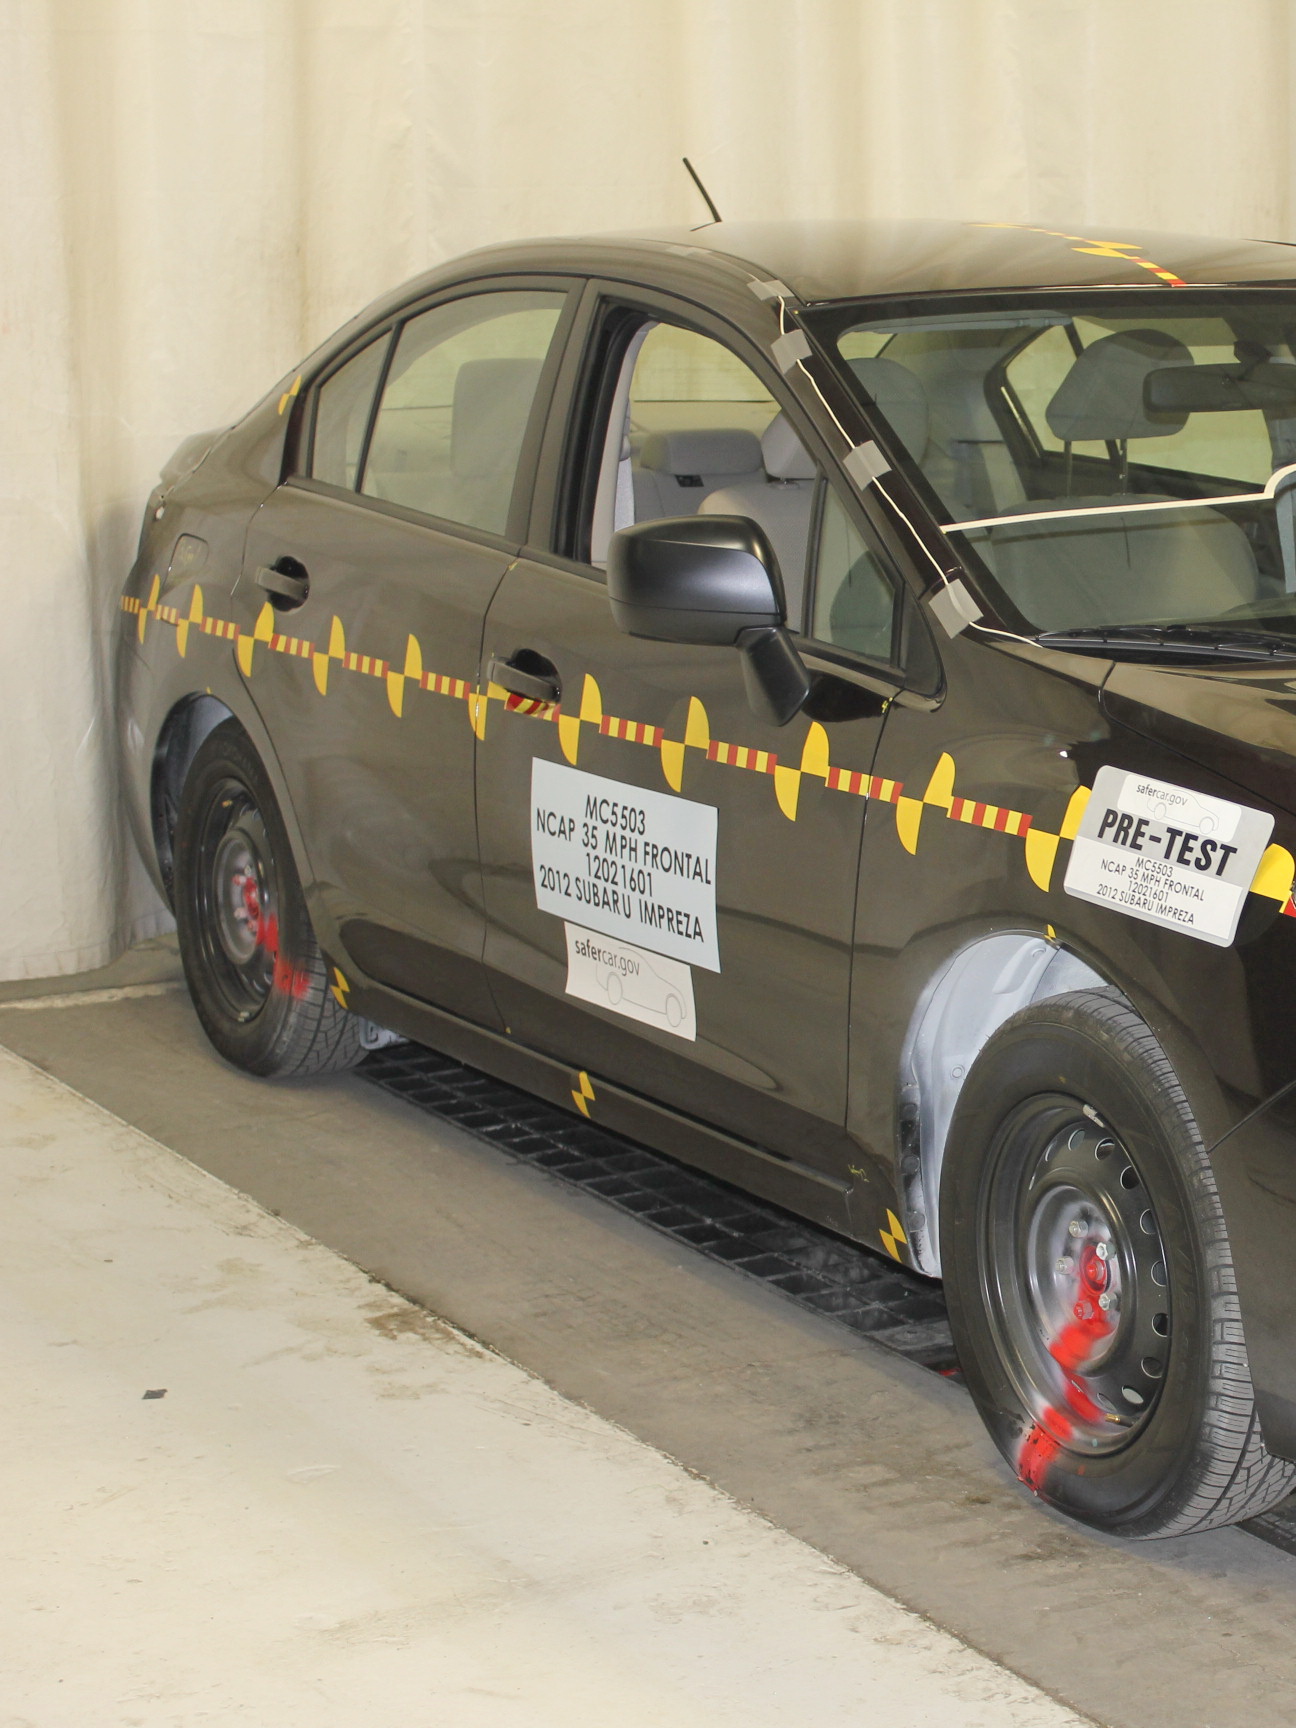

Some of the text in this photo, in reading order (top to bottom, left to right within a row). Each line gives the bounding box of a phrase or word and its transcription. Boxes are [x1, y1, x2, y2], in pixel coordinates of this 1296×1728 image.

[585, 794, 646, 836] MC5503
[1136, 783, 1188, 807] safercar.gov
[536, 807, 712, 885] NCAP 35 MPH FRONTAL
[1097, 808, 1238, 876] PRE-TEST
[585, 852, 653, 898] 12021601
[1100, 858, 1205, 902] NCAP 35 MPH FRONTAL
[1135, 857, 1173, 878] MC5503
[539, 864, 705, 943] 2012 SUBARU IMPREZA
[1096, 883, 1195, 924] 2012 SUBARU IMPREZA
[1127, 880, 1170, 903] 12021601
[574, 939, 641, 977] safercar.gov
